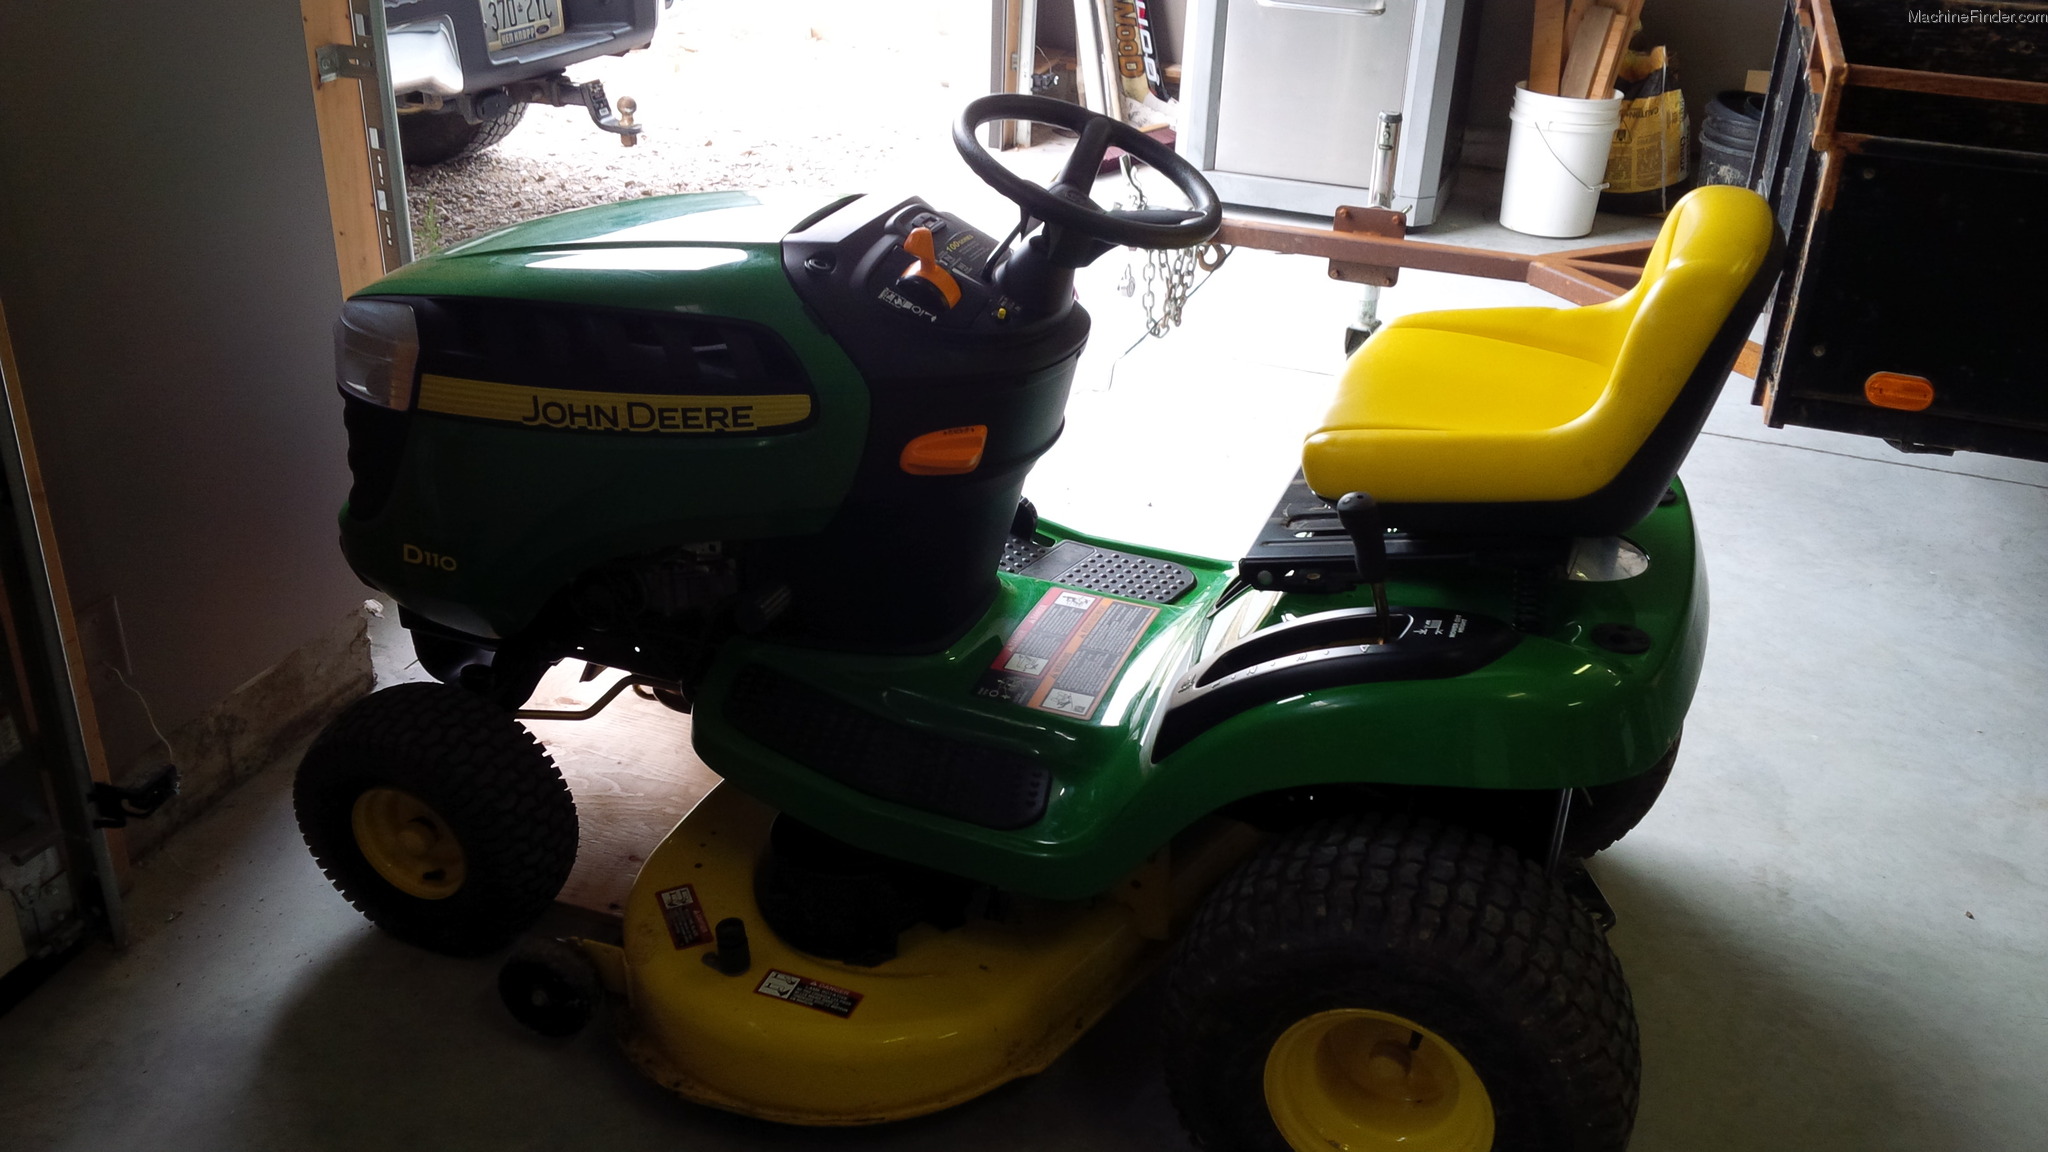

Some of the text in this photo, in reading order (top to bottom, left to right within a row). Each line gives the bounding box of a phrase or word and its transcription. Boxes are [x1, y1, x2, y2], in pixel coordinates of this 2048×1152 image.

[522, 395, 755, 430] JOHN DEERE
[402, 543, 457, 572] D110
